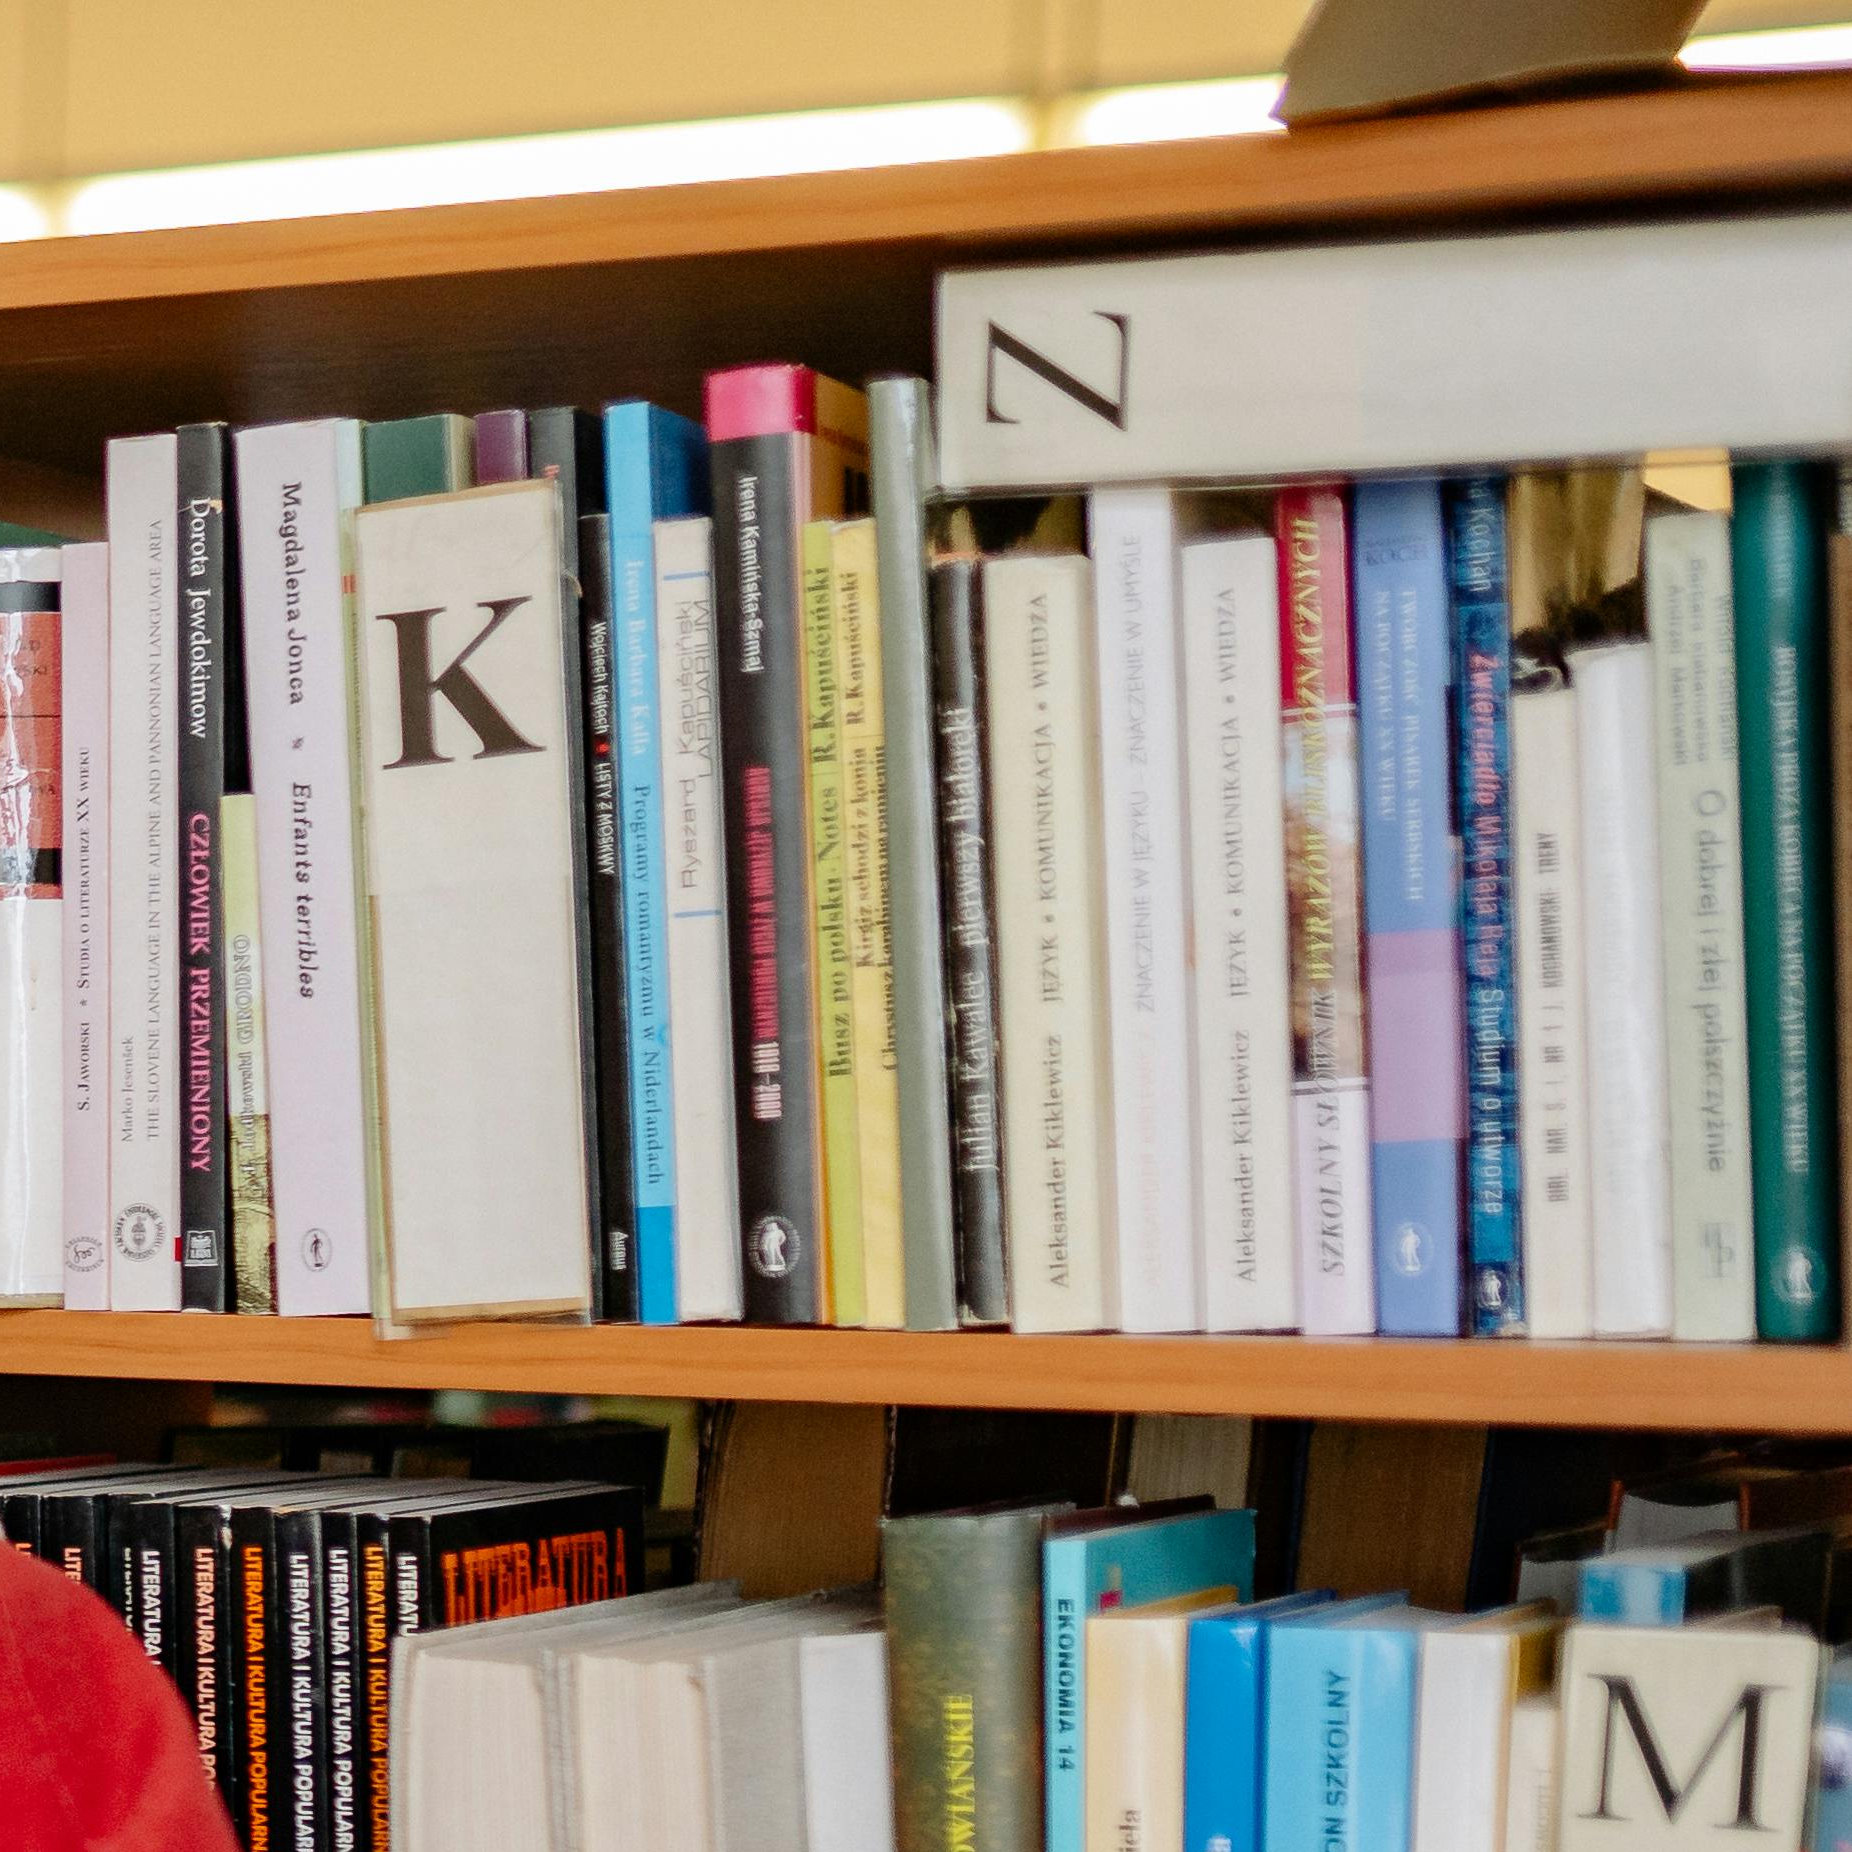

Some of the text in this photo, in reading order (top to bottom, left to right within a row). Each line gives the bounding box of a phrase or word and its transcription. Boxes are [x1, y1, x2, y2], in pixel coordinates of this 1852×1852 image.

[185, 496, 211, 738] Dorota Jewdokimow
[279, 481, 307, 705] Magdalena Jonca
[375, 594, 547, 770] K
[693, 600, 713, 777] LAPIDARIUM
[675, 601, 700, 889] Ryszard Kapuściński
[147, 520, 162, 1140] THE SLOVENE LANGUAGE IN THE ALPINE AND PANNONIAN LANGUAGE AREA
[597, 762, 614, 875] LISTY Z MOSKWY
[817, 788, 840, 860] Notes
[293, 782, 319, 999] Enfants terribles
[819, 878, 848, 963] polsku
[1030, 593, 1069, 1288] Aleksander Kiklewicz JĘZYK KOMUNIKACJA WIEDZA
[1217, 588, 1257, 1282] Aleksander Kiklewicz JĘZYK KOMUNIKACJA WIEDZA
[189, 813, 211, 1172] CZŁOWIEK PRZEMIENIONY
[630, 785, 664, 1184] Programy romantyzmu w Niderlandach
[832, 971, 850, 1002] po
[120, 1037, 136, 1142] Marko Jesenšek
[828, 1012, 852, 1076] Busz
[1317, 1140, 1345, 1276] SZKOLNY
[142, 1550, 162, 1656] LITERATURA
[197, 1548, 215, 1654] LITERATURA
[245, 1547, 263, 1653] LITERATURA
[290, 1554, 310, 1659] LITERATURA
[330, 1549, 350, 1655] LITERATURA
[365, 1546, 385, 1652] LITERATURA
[198, 1666, 216, 1750] KULTURA
[248, 1665, 266, 1748] KULTURA
[293, 1676, 312, 1759] KULTURA
[332, 1672, 352, 1754] KULTURA
[369, 1669, 387, 1751] KULTURA
[1058, 1599, 1076, 1771] EKONOMIA 14
[1325, 1670, 1350, 1806] SZKOLNY
[1578, 1673, 1791, 1832] M
